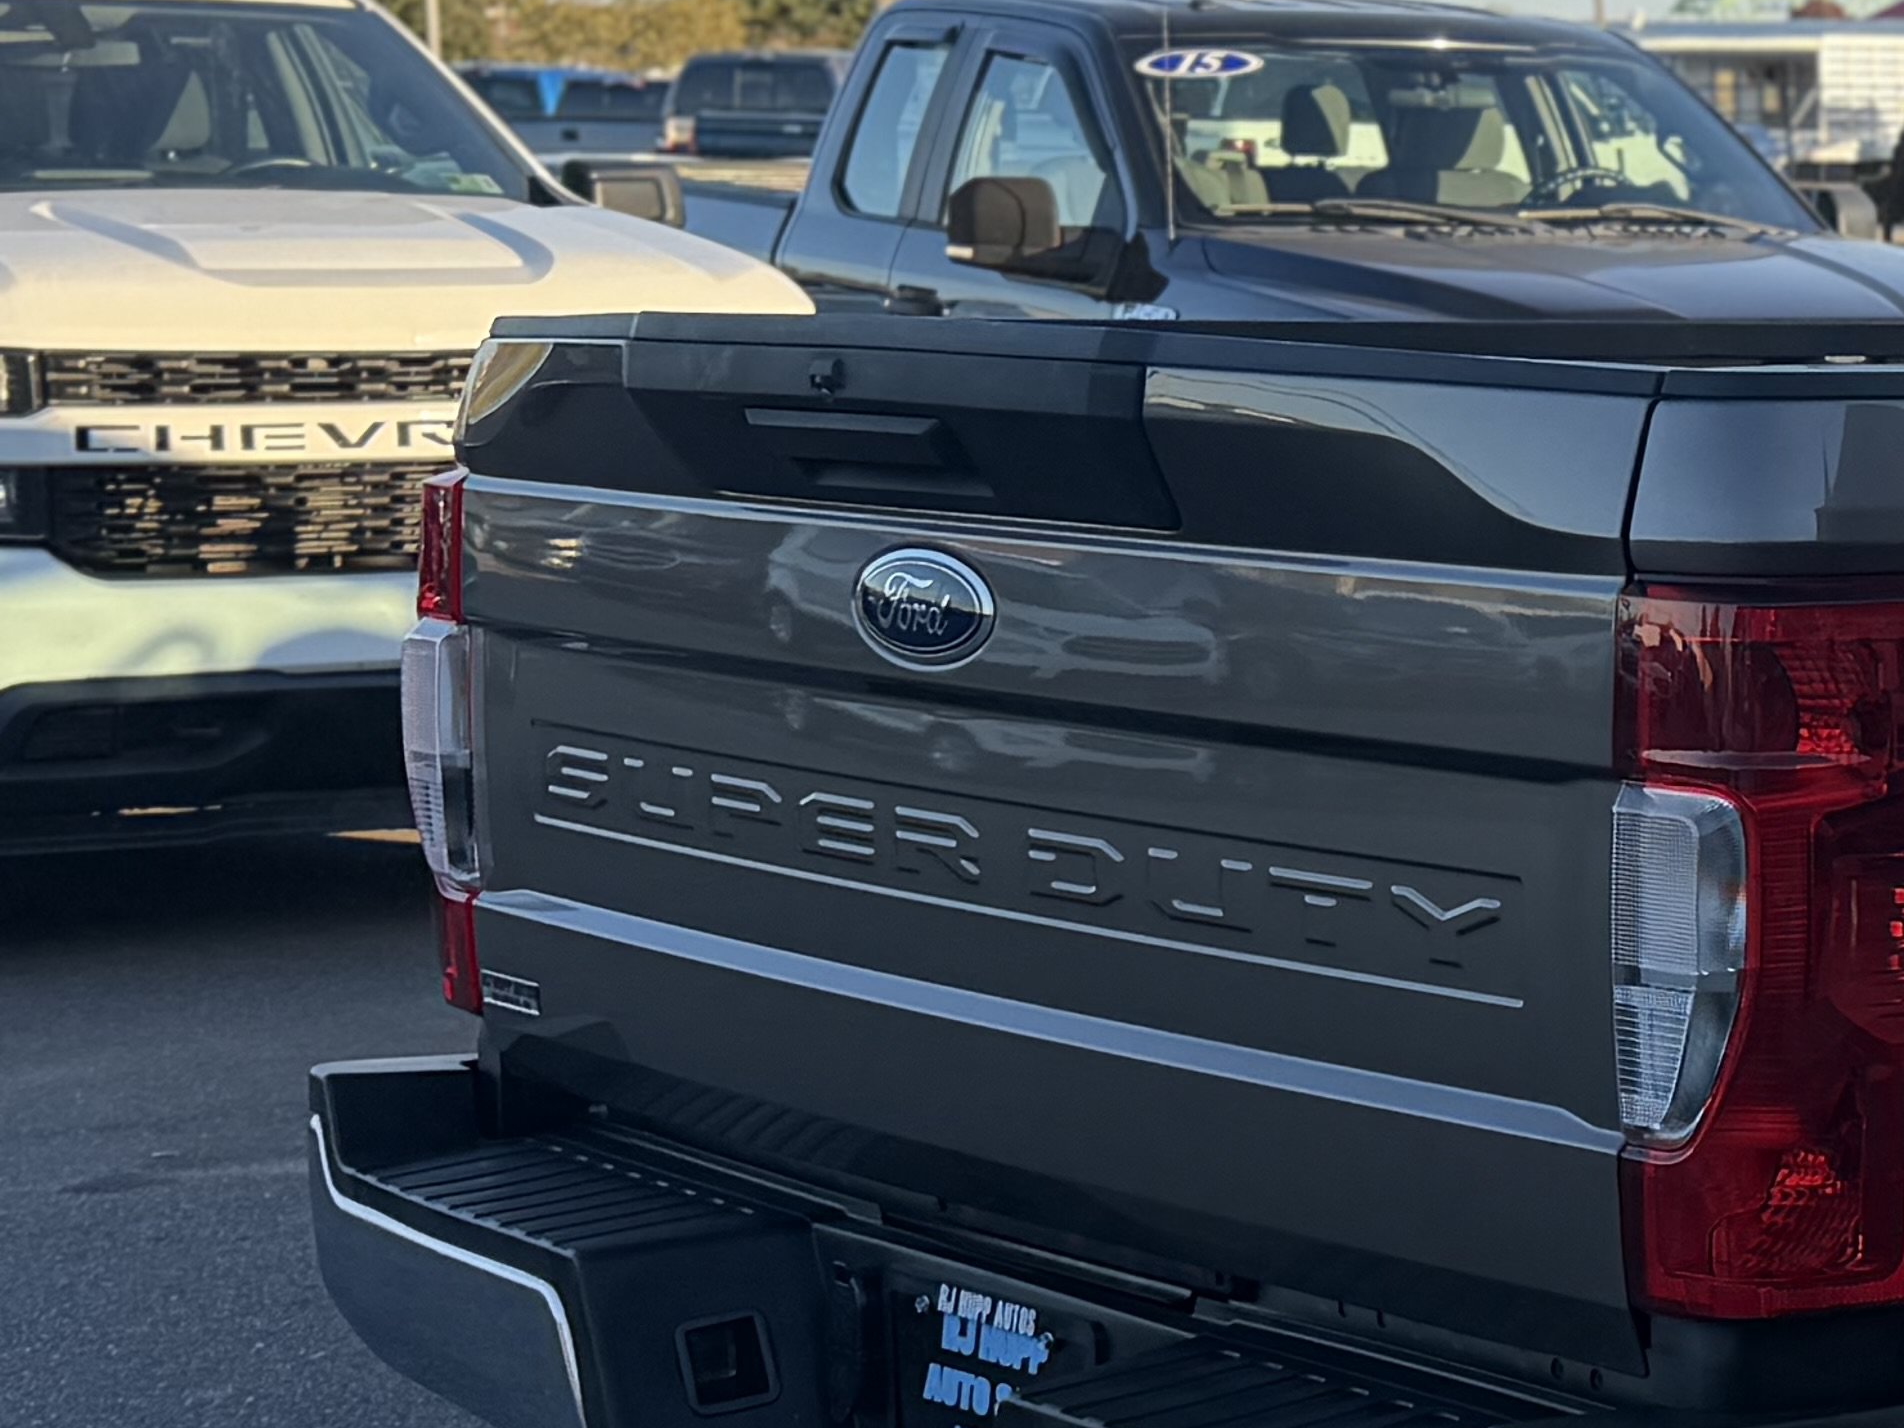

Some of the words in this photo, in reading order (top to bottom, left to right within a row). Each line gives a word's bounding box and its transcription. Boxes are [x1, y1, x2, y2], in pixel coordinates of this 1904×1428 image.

[1172, 50, 1224, 74] 15
[75, 420, 454, 452] CHEVR
[876, 572, 951, 636] Ford
[546, 745, 981, 886] SUPER
[1027, 828, 1501, 969] DUTY
[993, 1300, 1037, 1337] AUTOS
[922, 1362, 992, 1416] AUTO
